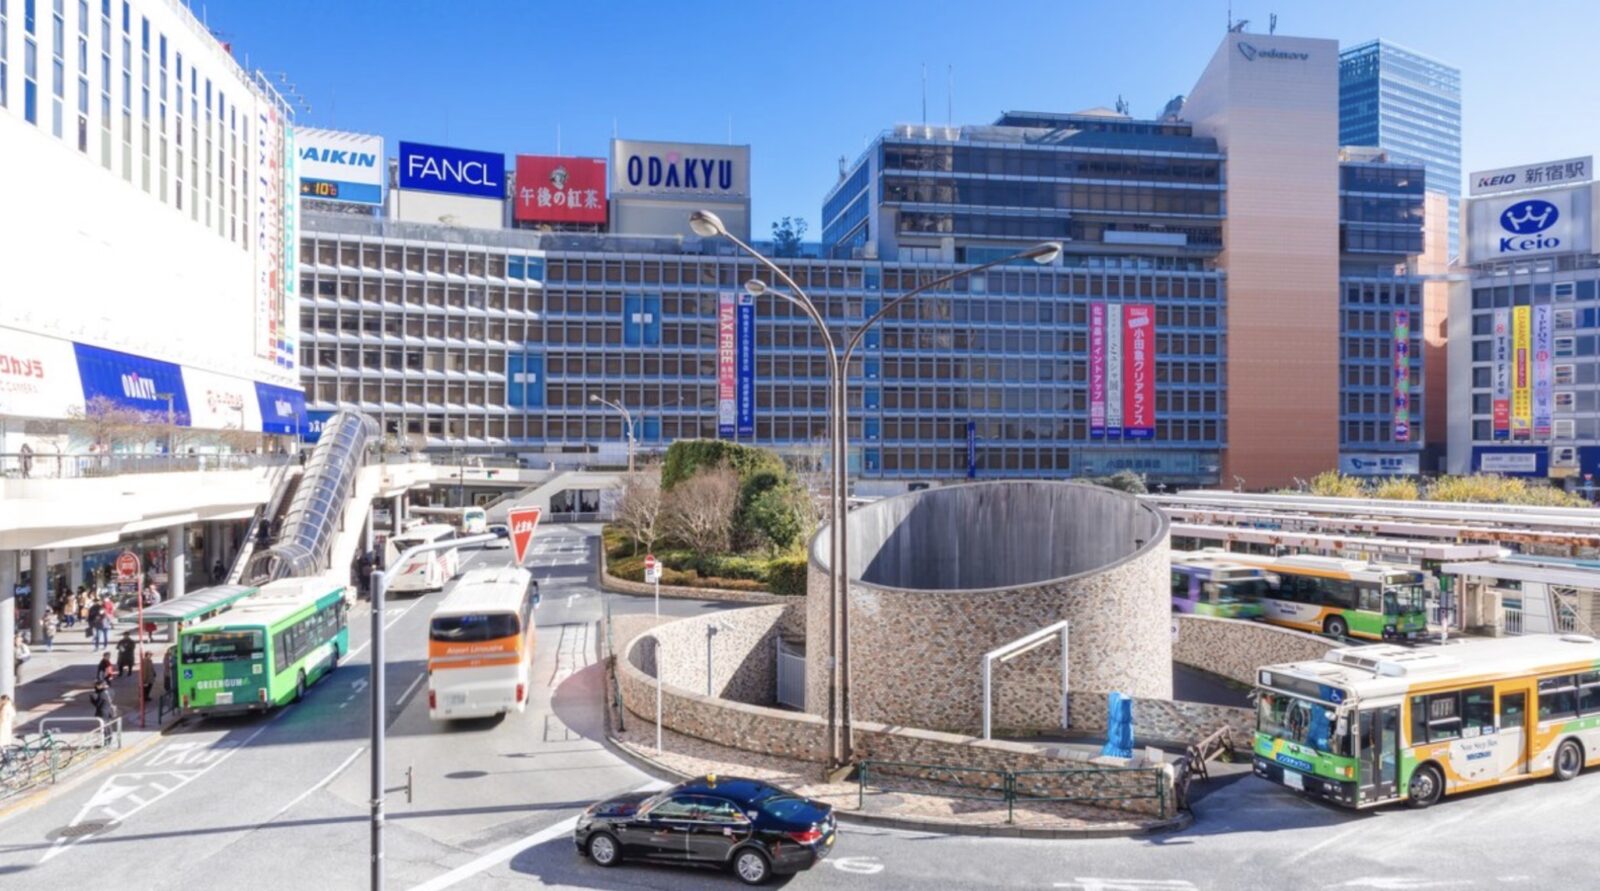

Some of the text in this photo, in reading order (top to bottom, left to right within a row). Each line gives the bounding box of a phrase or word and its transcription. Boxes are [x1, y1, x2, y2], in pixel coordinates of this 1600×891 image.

[408, 155, 497, 187] FANCL
[627, 152, 733, 190] ODAKYU
[1478, 161, 1585, 188] KEIO 新宿駅
[520, 186, 599, 209] 午後の紅茶
[1500, 234, 1560, 252] Keio
[720, 306, 734, 332] TAX
[720, 333, 734, 364] FREE
